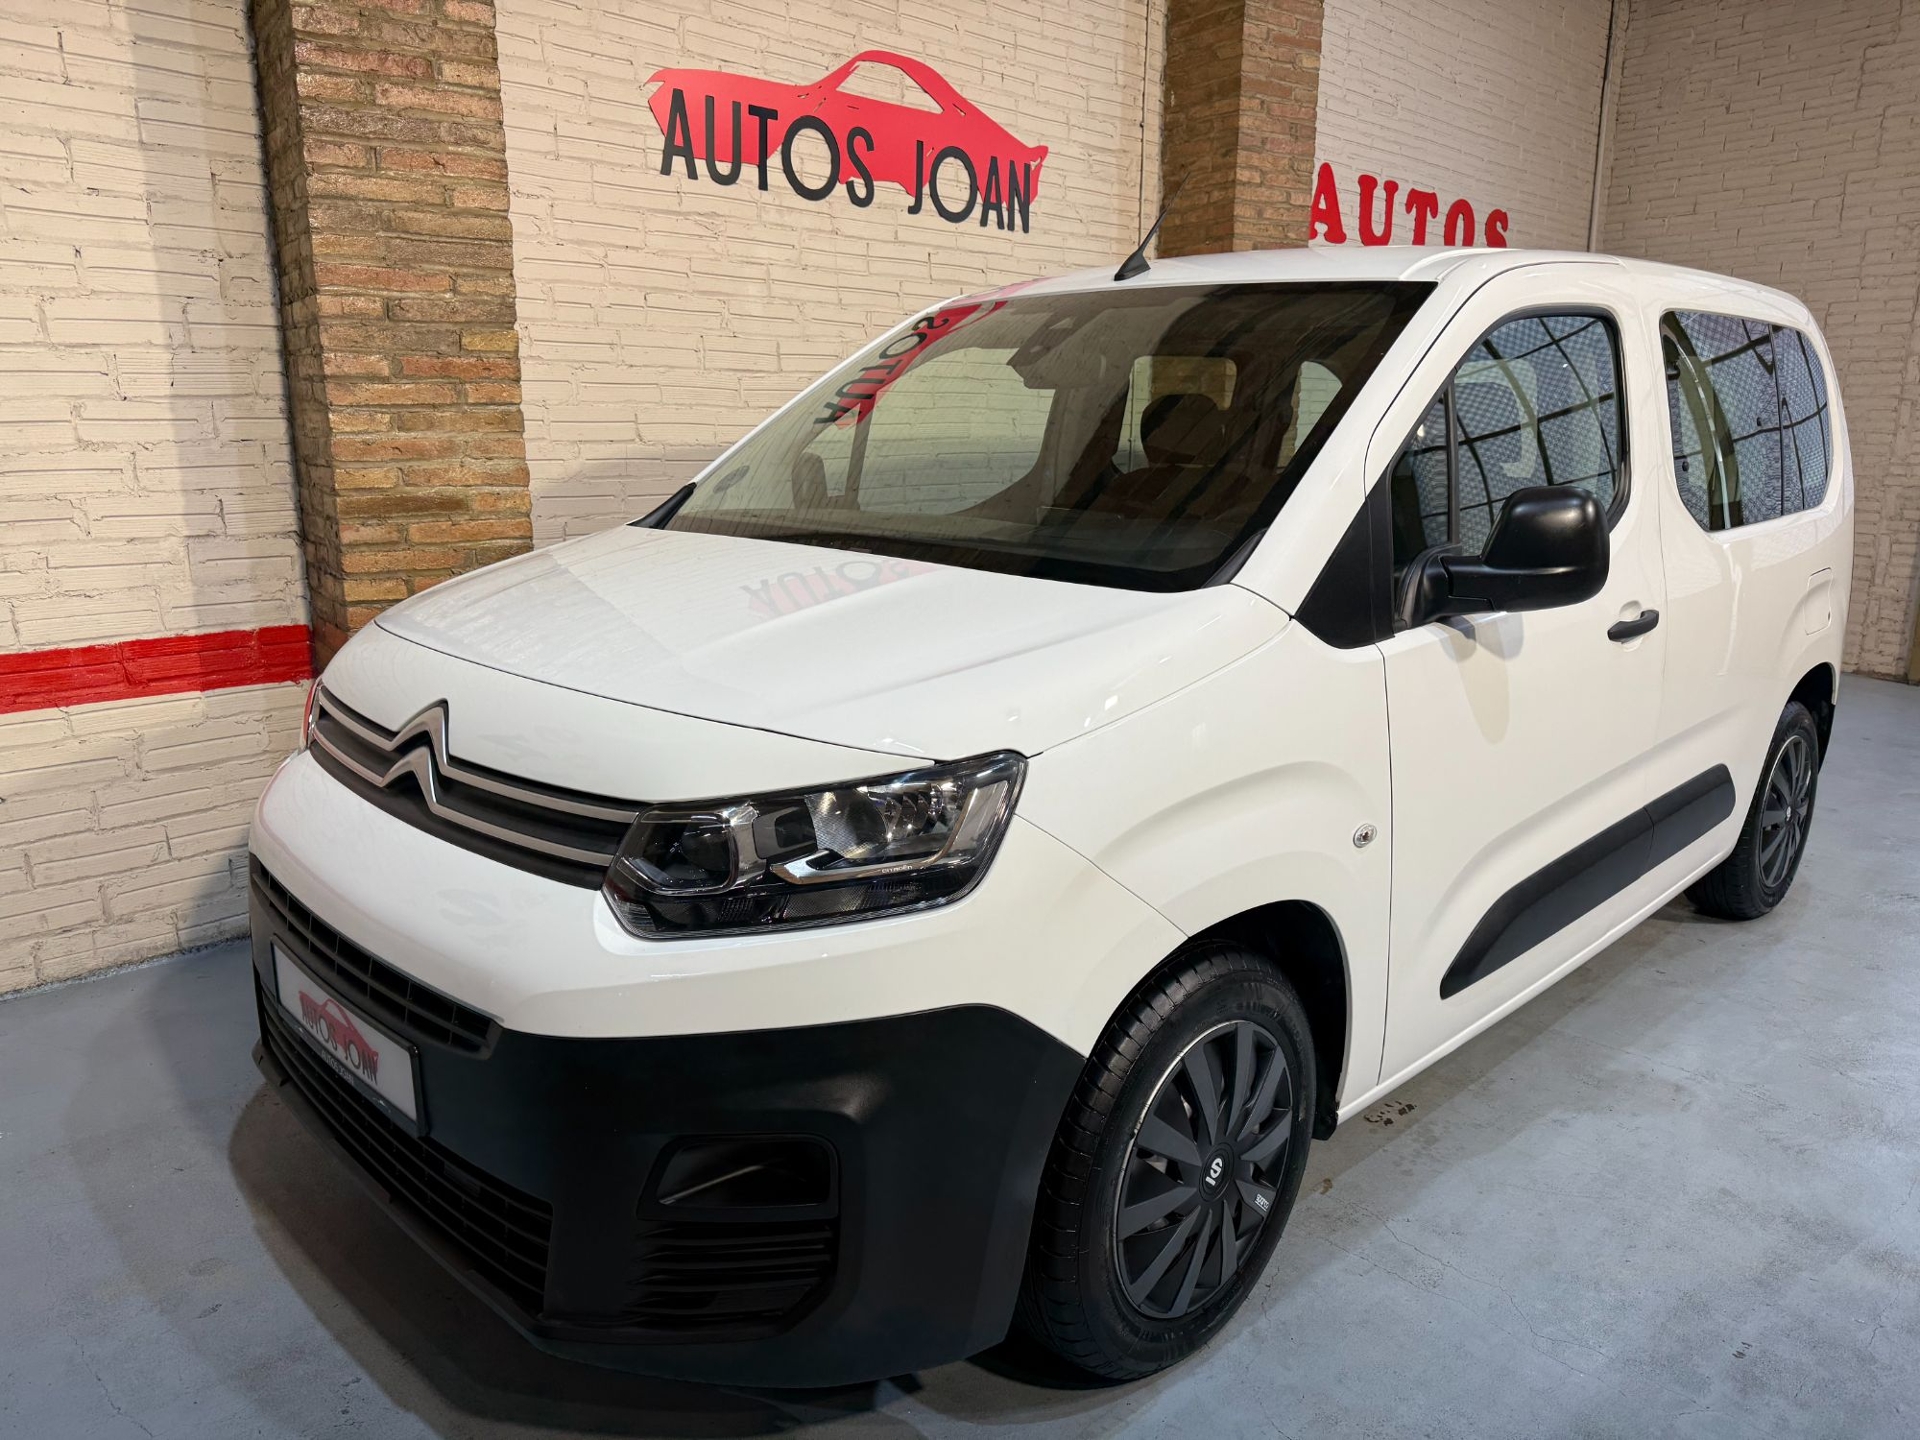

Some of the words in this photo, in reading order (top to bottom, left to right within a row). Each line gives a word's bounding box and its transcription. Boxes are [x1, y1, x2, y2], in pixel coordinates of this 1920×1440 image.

[660, 88, 875, 208] AUTOS
[908, 140, 1031, 234] JOAN
[1309, 162, 1509, 248] AUTOS
[301, 1001, 338, 1051] AUTOS
[344, 1034, 378, 1086] JOAN
